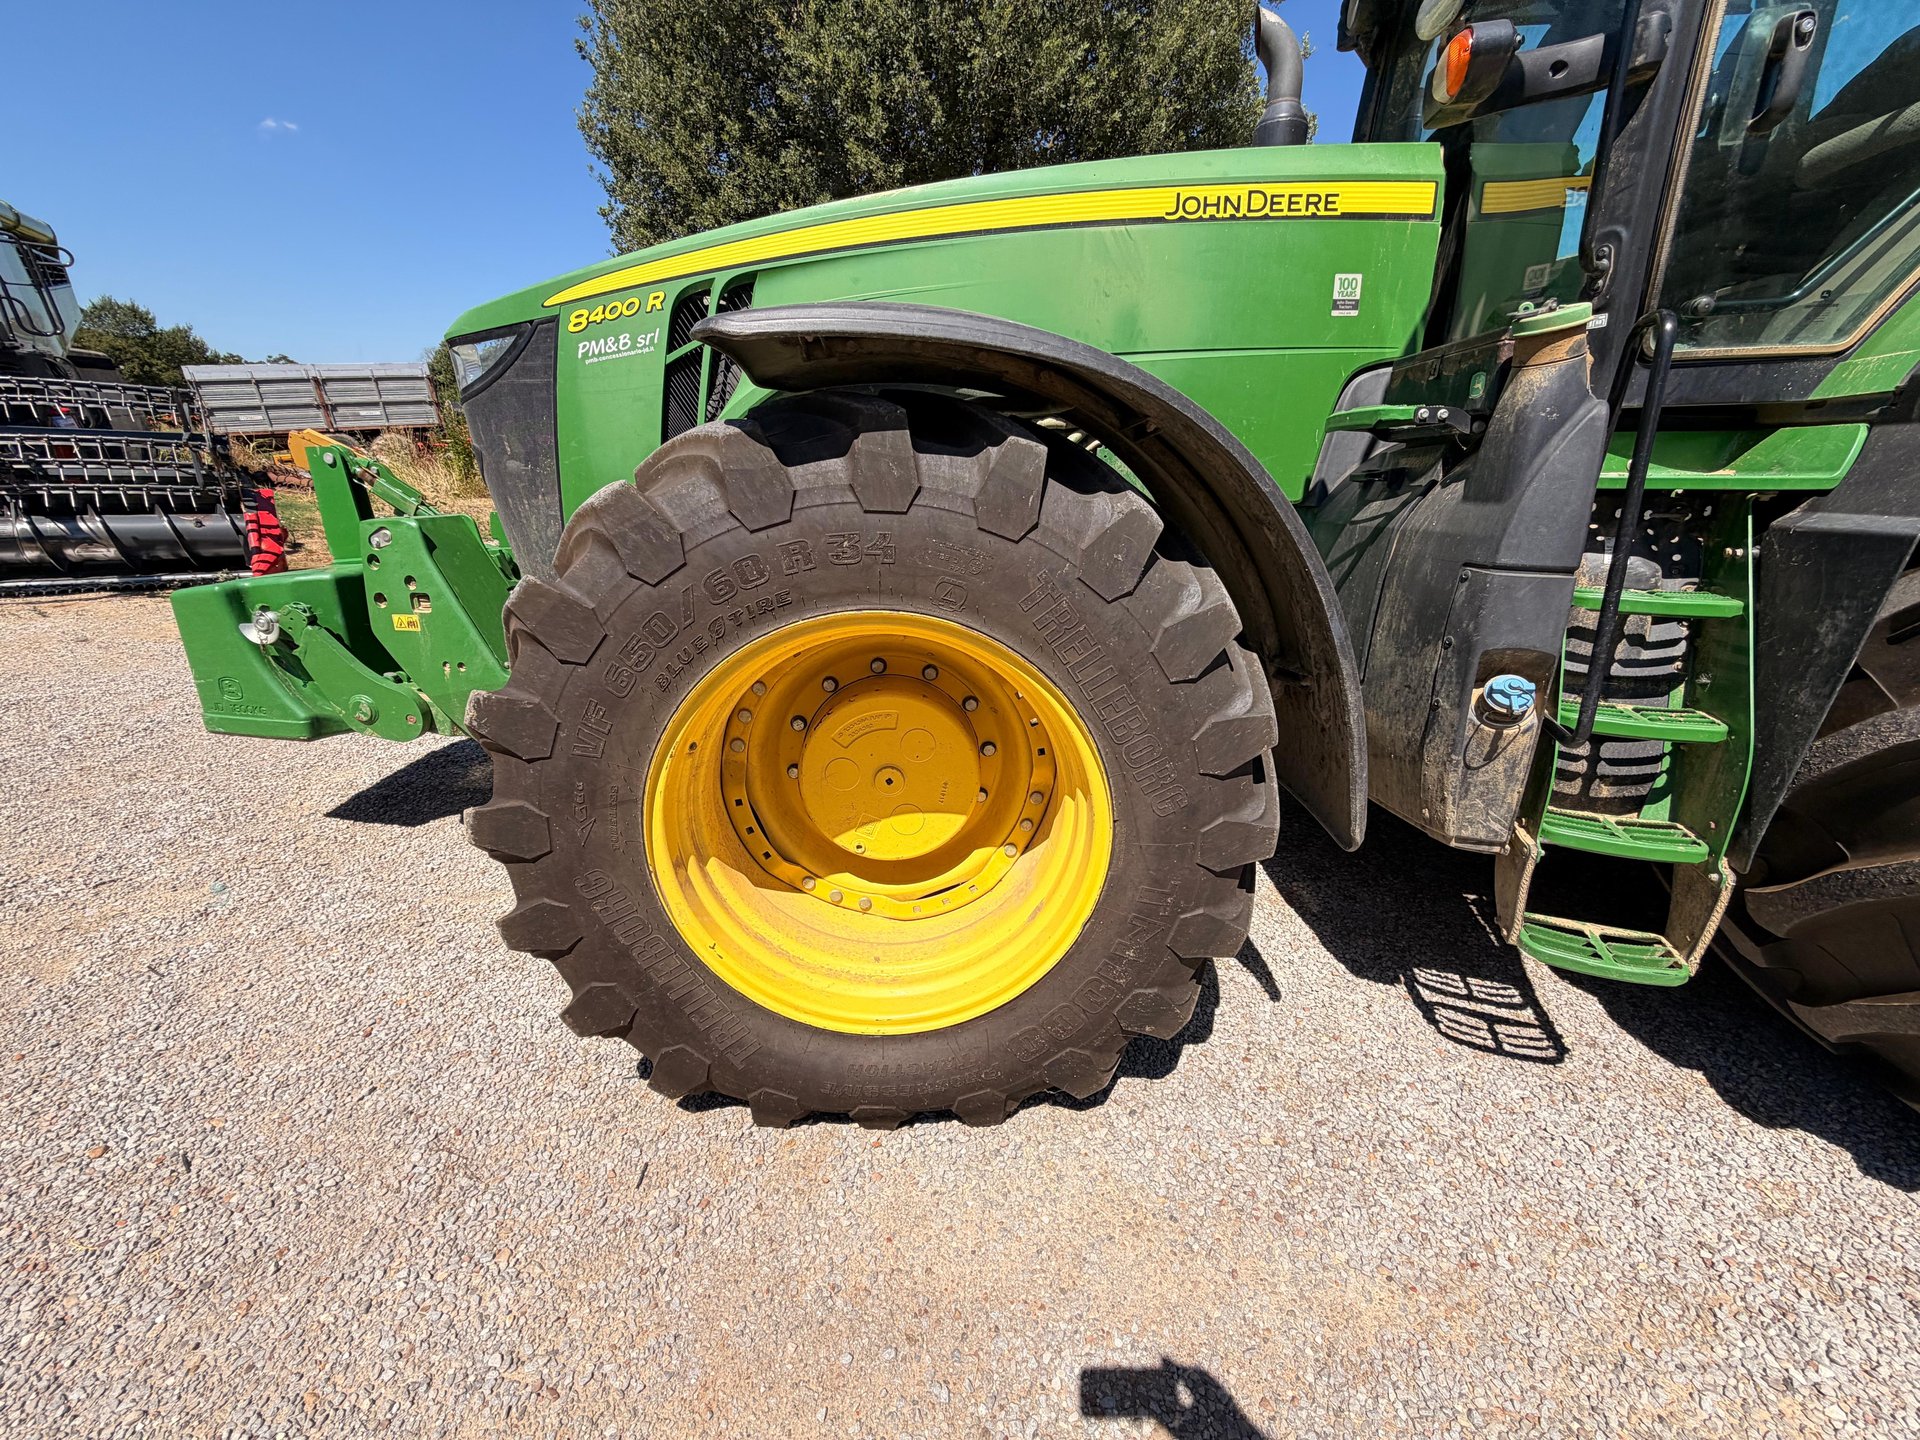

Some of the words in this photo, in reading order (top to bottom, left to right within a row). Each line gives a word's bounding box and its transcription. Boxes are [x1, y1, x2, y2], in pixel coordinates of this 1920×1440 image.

[1165, 192, 1241, 215] JOHN
[1246, 189, 1340, 213] DEERE
[1337, 290, 1357, 298] YEARS
[1338, 277, 1358, 290] 100
[567, 297, 640, 333] 8400
[645, 290, 666, 315] R
[577, 332, 632, 359] PM&B
[636, 328, 660, 347] srl
[571, 699, 613, 759] VF
[603, 553, 770, 699] 650/60
[776, 538, 817, 576] R
[825, 531, 897, 565] 34
[653, 634, 709, 692] BLUE
[727, 588, 792, 627] TIRE
[1017, 568, 1189, 818] TRELLEBORG
[573, 868, 762, 1071] TRELLEBORG
